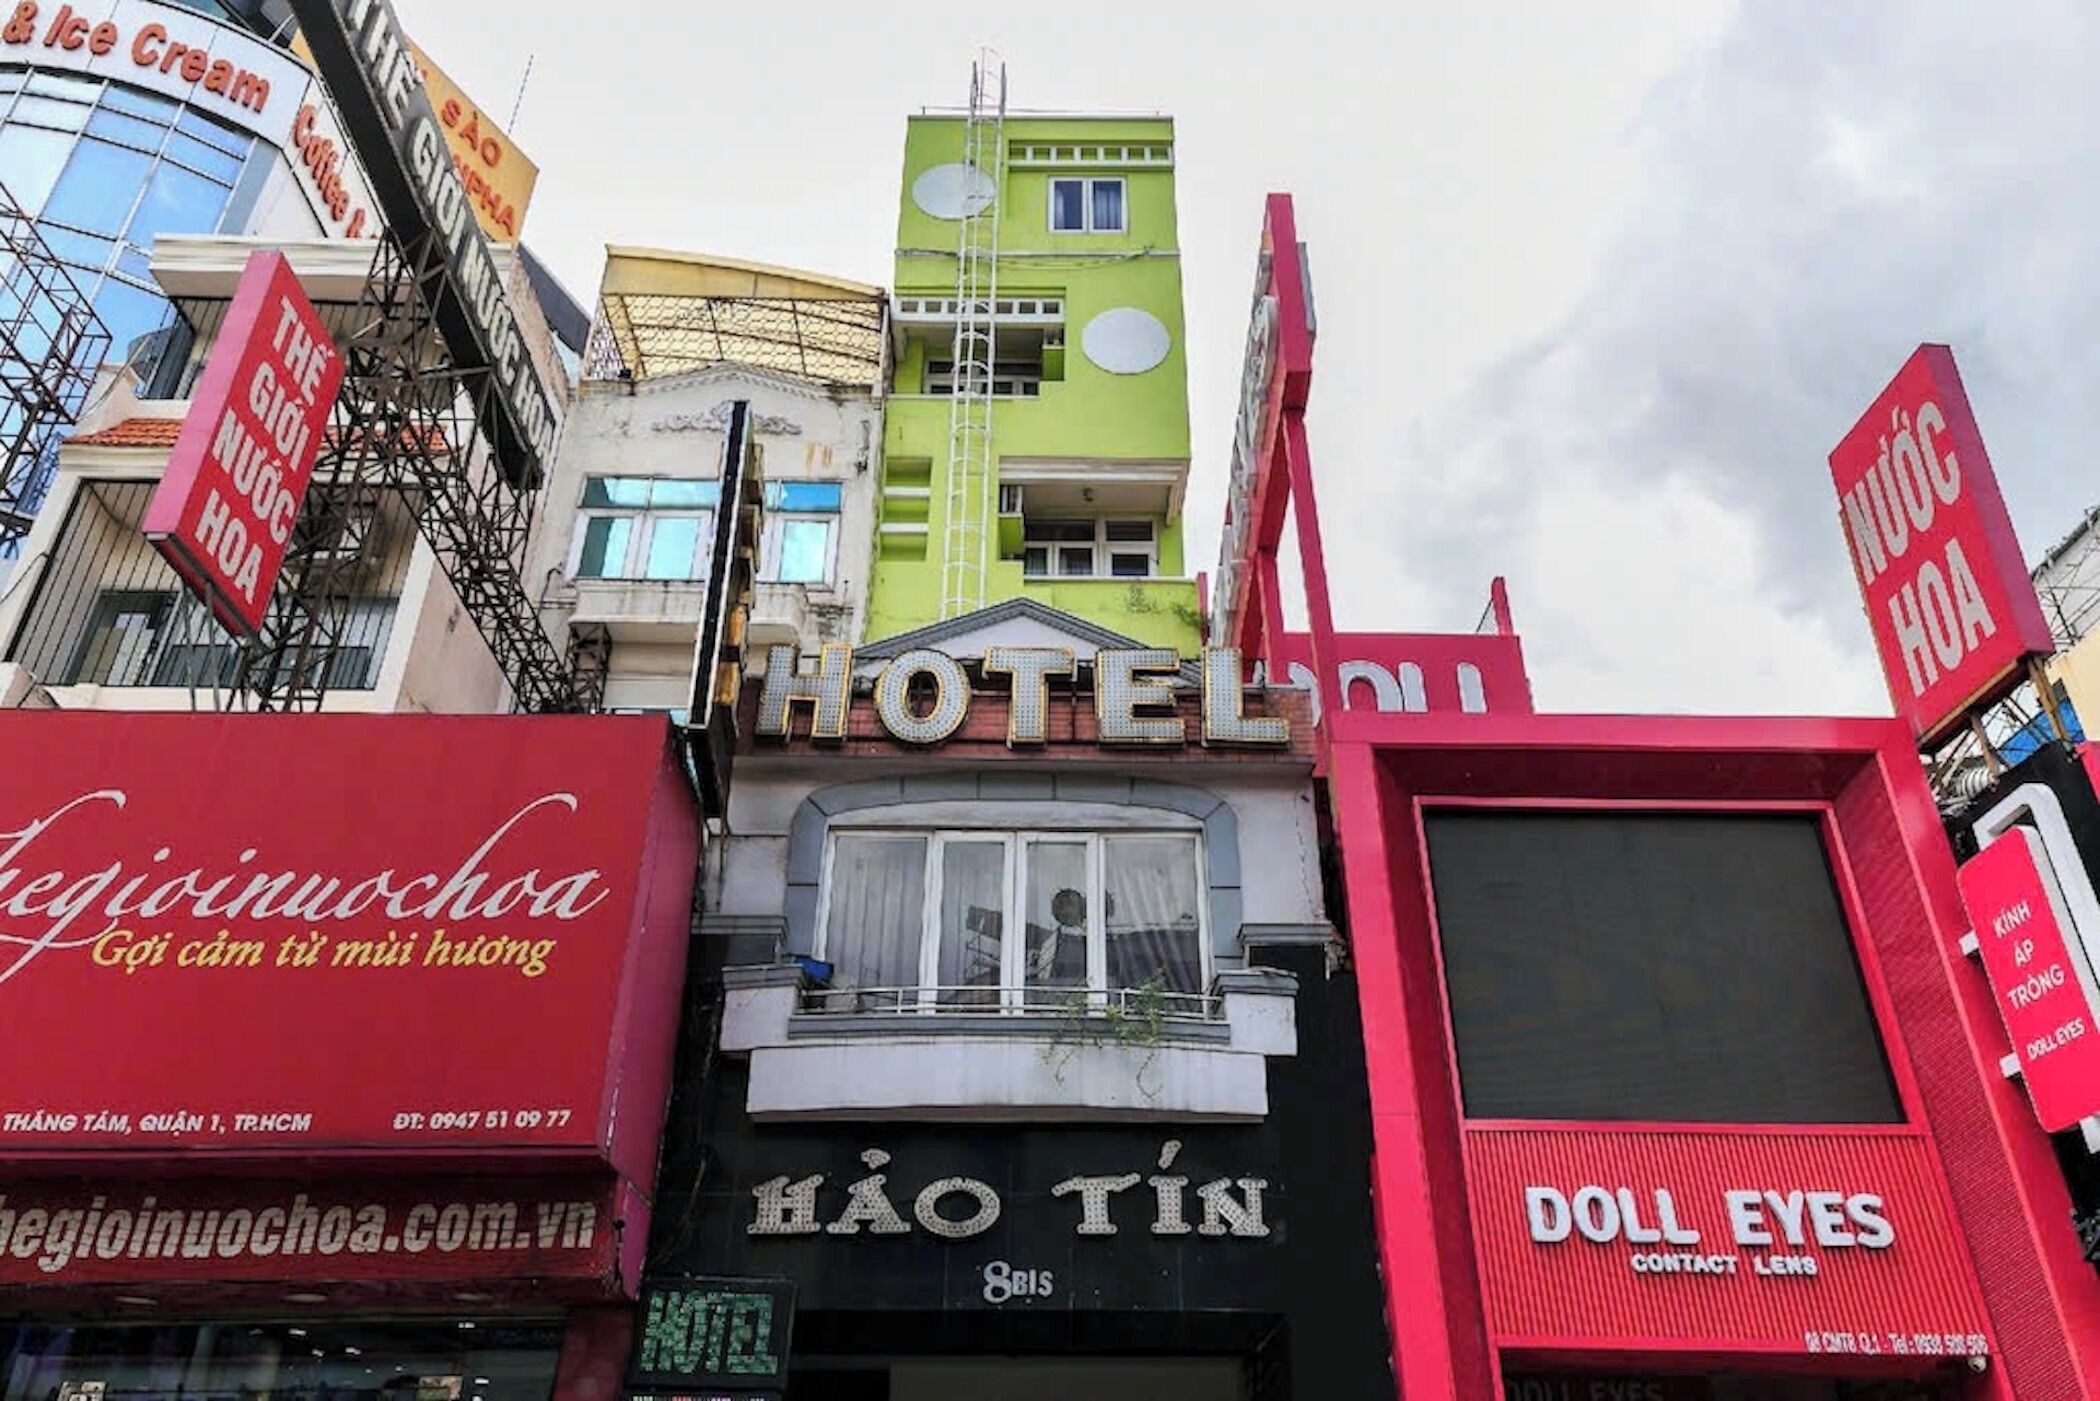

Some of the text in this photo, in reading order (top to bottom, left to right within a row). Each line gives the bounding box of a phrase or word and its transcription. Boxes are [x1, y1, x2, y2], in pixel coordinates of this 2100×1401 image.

[2, 1, 270, 113] & Ice Cream
[293, 104, 349, 222] Coffee
[272, 294, 335, 407] THẾ
[249, 361, 310, 472] GIỚI
[212, 407, 295, 545] NƯỚC
[1843, 401, 1961, 585] NƯỚC
[194, 487, 263, 605] HOA
[1888, 537, 1996, 698] HOA
[756, 643, 1290, 747] HOTEL
[91, 929, 557, 977] Gợi cảm từ mùi hương
[1993, 900, 2031, 938] KÍNH
[2013, 938, 2034, 967] ÁP
[2026, 1017, 2085, 1061] DOLL EYES
[2, 1110, 313, 1137] THÁNG TÁM, QUẬN 1, TP.HCM
[393, 1110, 572, 1131] ĐT: 0947 51 09 77
[747, 1140, 1270, 1237] HẢO TÍN
[1525, 1185, 1895, 1249] DOLL EYES
[1631, 1253, 1817, 1277] CONTACT LENS
